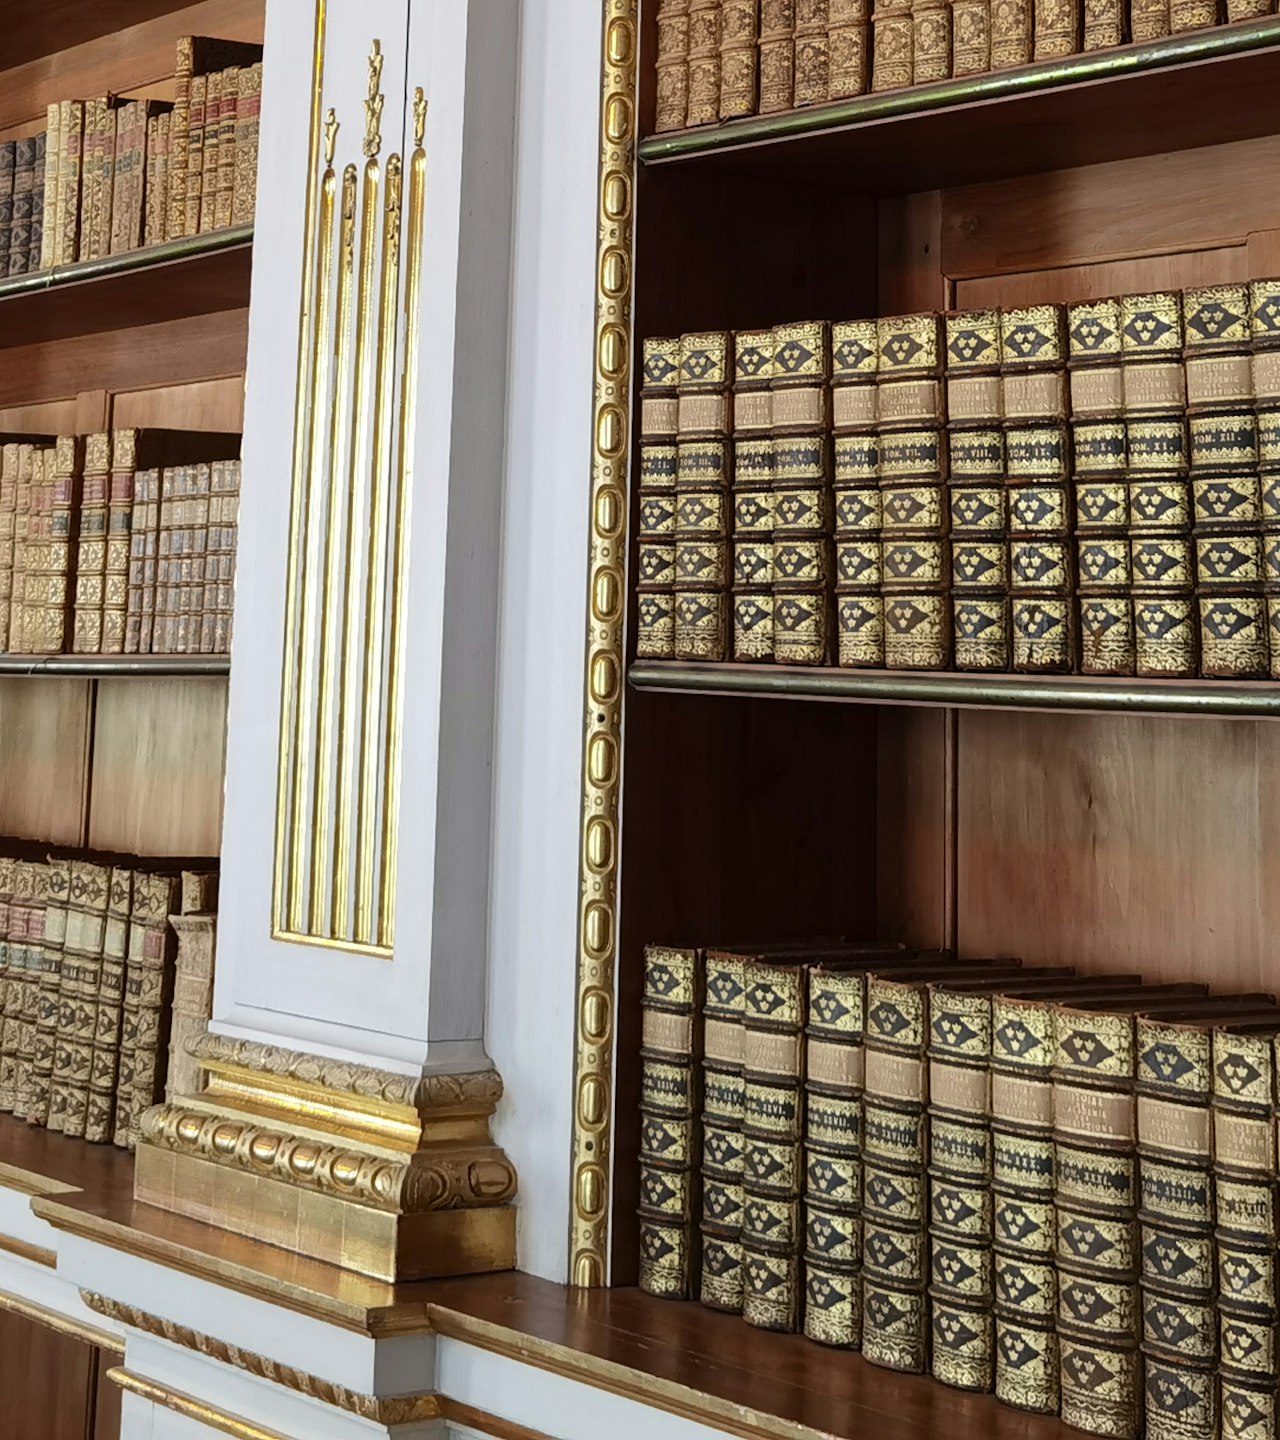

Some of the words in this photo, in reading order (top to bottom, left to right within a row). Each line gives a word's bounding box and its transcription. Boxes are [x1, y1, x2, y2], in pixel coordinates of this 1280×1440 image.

[1194, 434, 1215, 444] TOM.
[1220, 432, 1241, 441] XII.
[1033, 447, 1051, 456] IX.
[1100, 442, 1112, 451] X.
[1129, 441, 1150, 452] TOM.
[1154, 441, 1174, 451] XI.
[971, 448, 992, 458] VIII.
